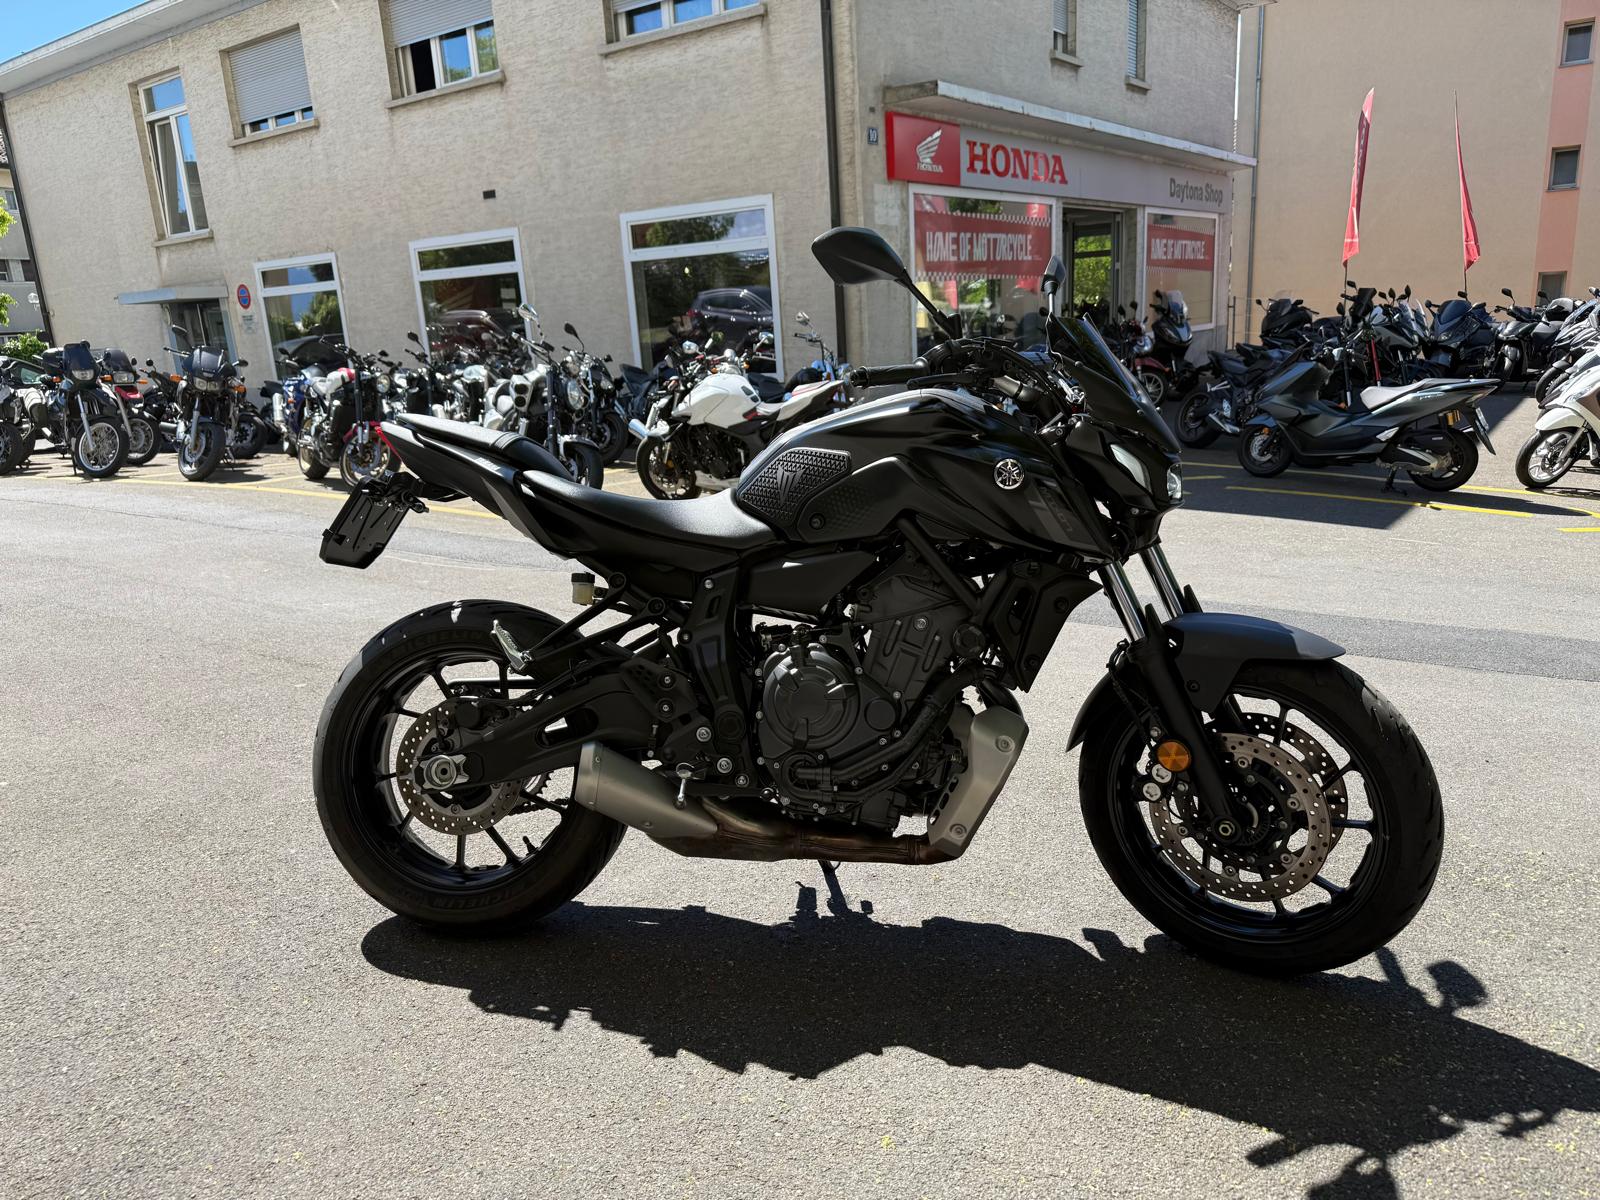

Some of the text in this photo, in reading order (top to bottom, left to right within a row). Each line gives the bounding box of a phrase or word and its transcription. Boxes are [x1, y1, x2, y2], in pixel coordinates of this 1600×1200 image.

[916, 162, 944, 173] HONDA
[965, 139, 1069, 185] HONDA
[1169, 177, 1223, 208] Daytona Shop
[960, 231, 972, 262] OF
